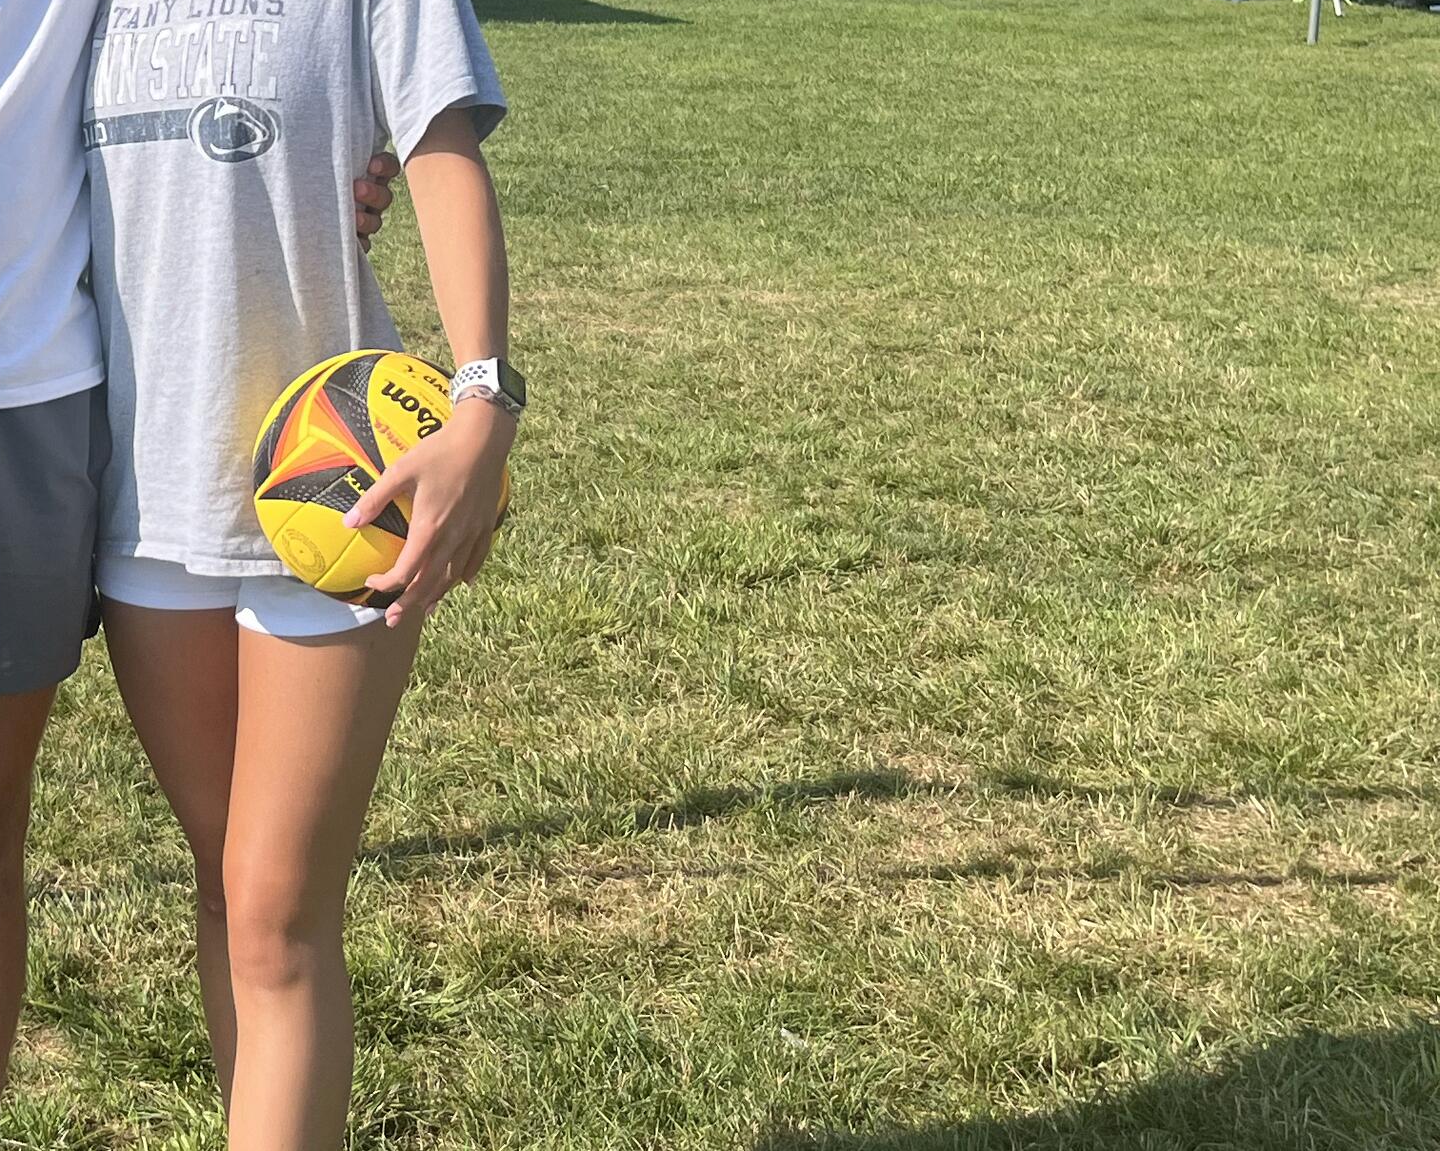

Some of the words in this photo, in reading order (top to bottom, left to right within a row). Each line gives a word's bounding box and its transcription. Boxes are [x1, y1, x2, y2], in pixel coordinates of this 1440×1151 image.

[93, 31, 148, 109] NN
[148, 20, 281, 102] STATE
[380, 379, 443, 440] lson
